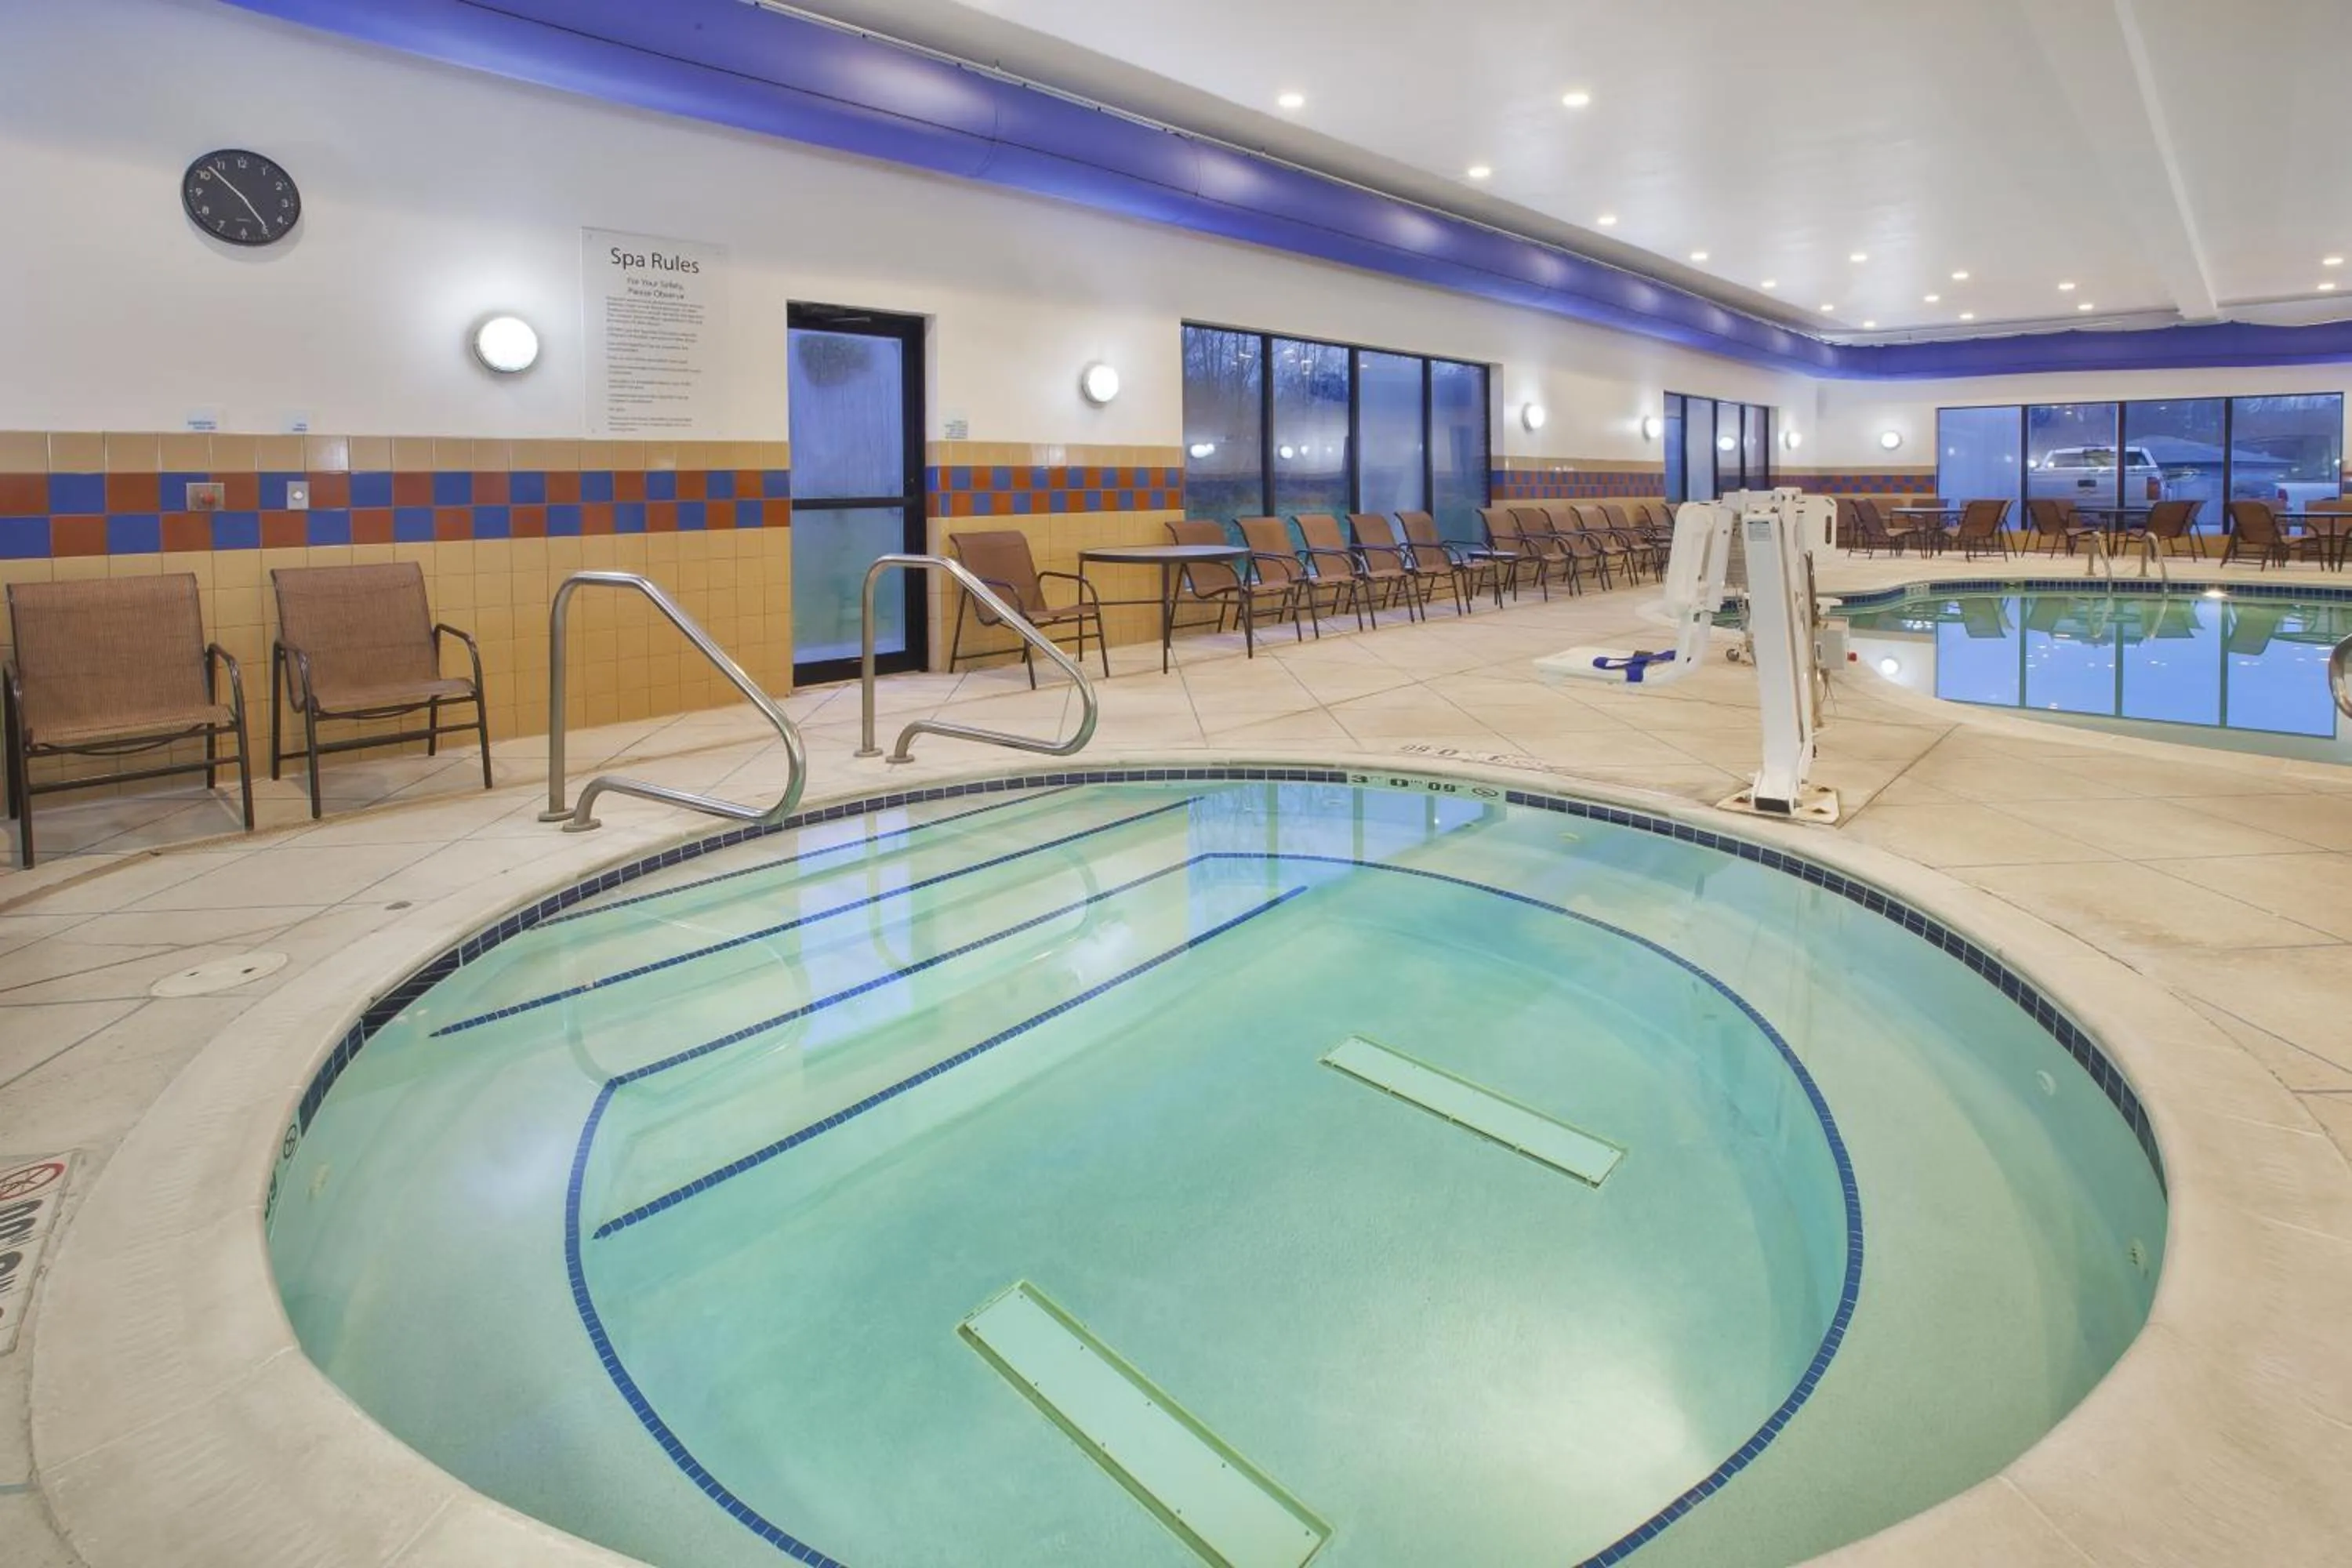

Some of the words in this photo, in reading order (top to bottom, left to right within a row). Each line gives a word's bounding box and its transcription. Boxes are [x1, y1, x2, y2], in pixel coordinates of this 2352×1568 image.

[275, 181, 283, 191] 2
[610, 247, 645, 270] Spa
[651, 252, 700, 274] Rules
